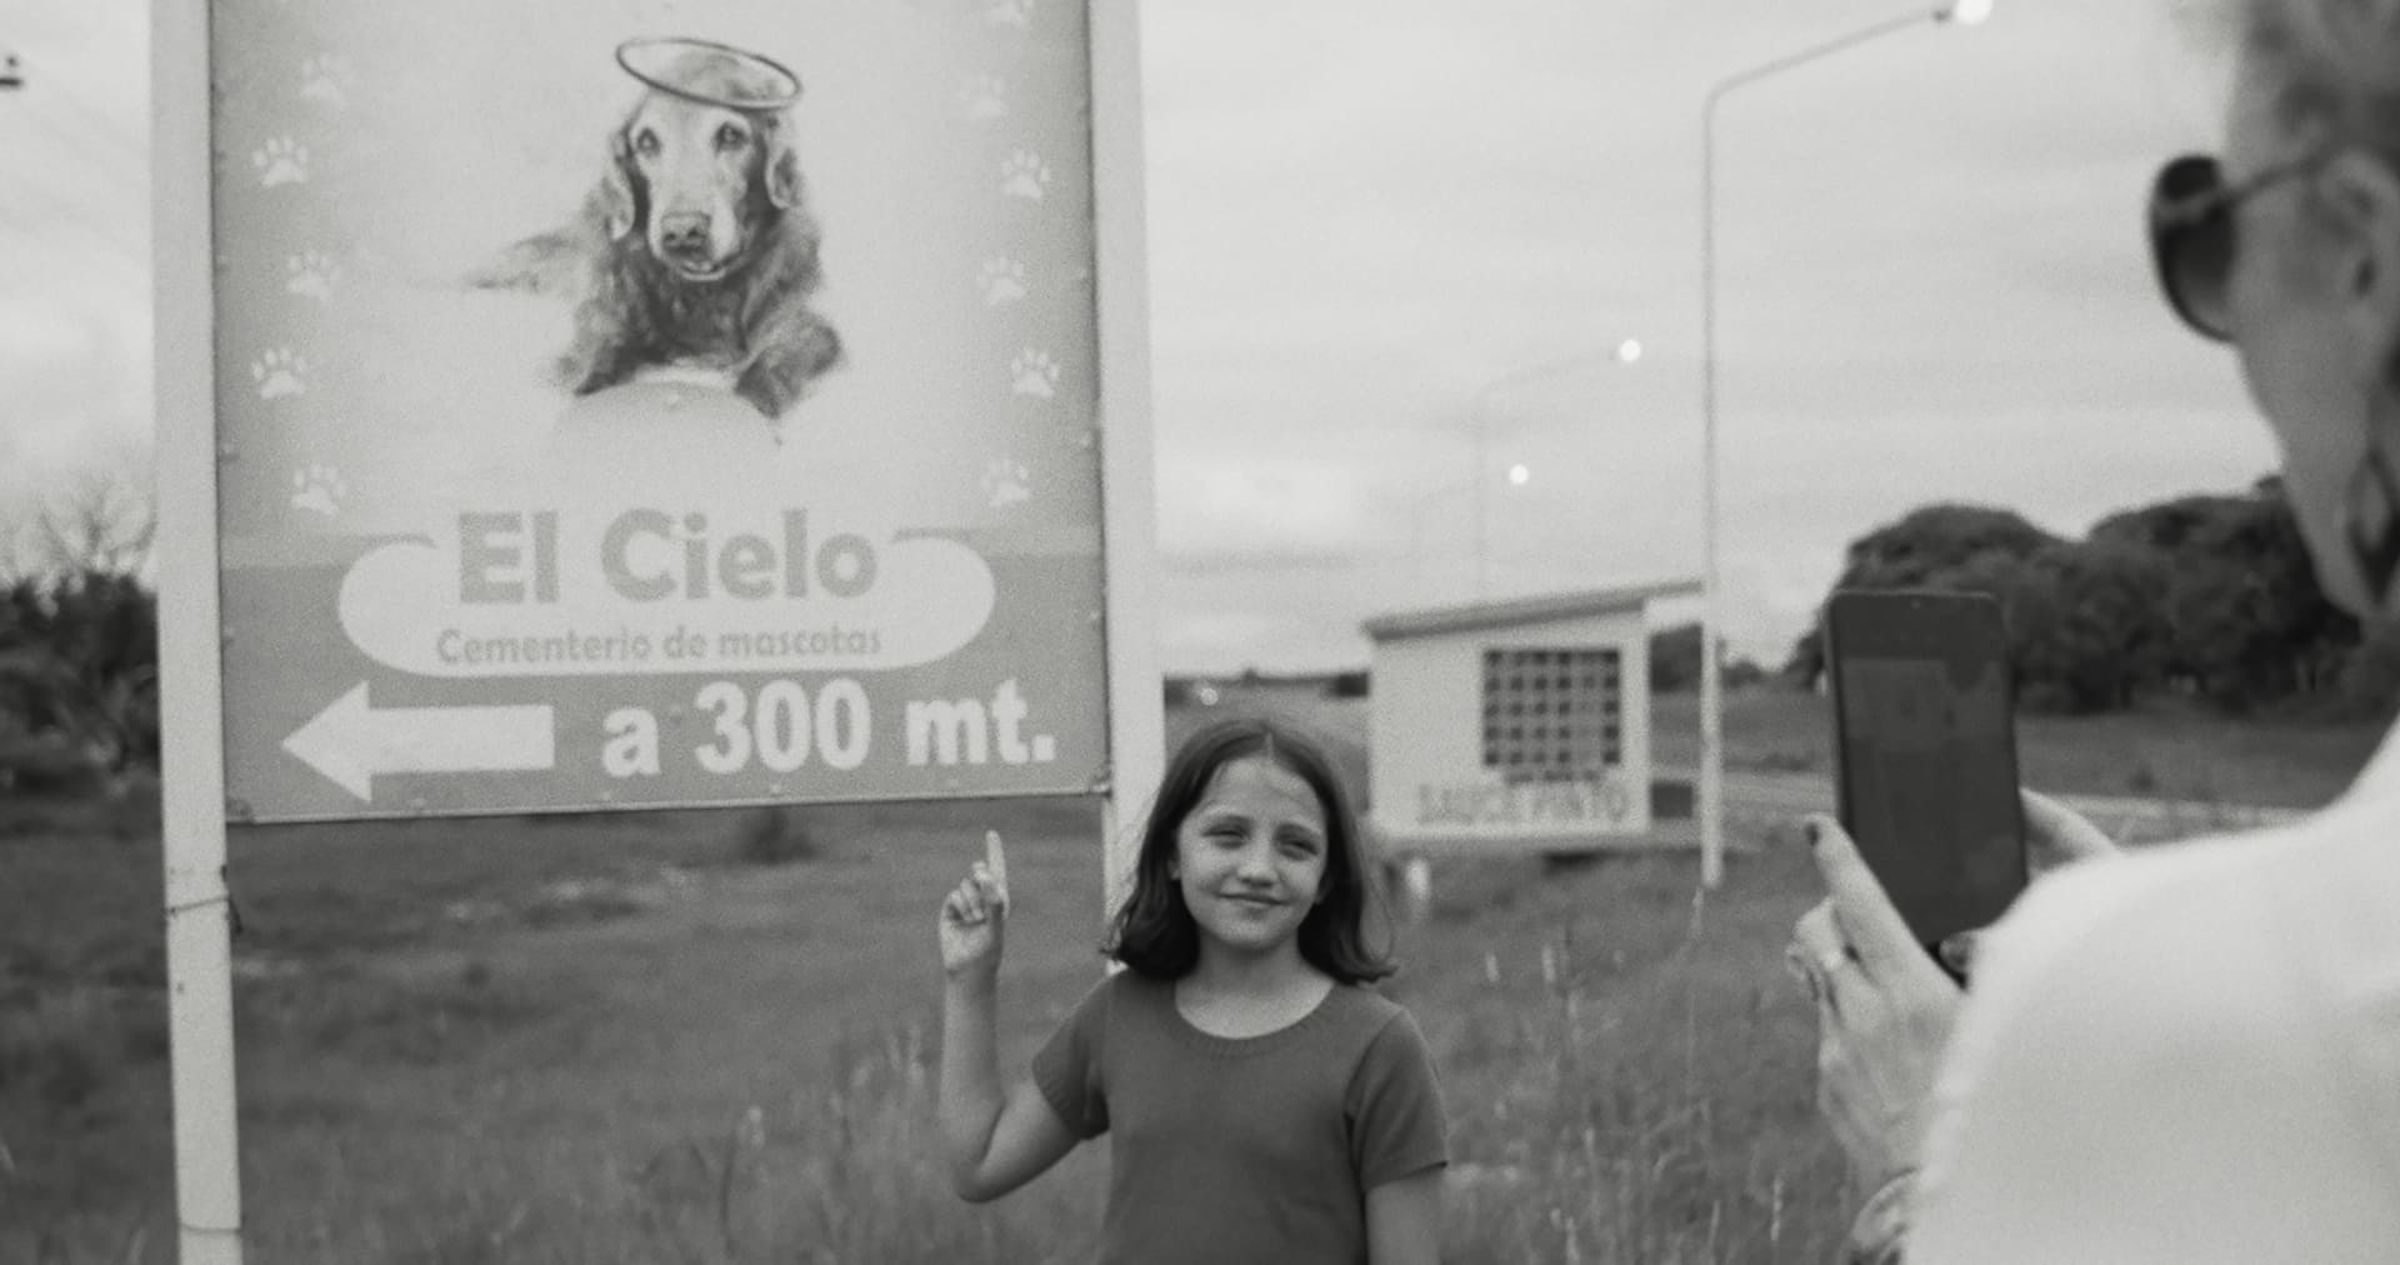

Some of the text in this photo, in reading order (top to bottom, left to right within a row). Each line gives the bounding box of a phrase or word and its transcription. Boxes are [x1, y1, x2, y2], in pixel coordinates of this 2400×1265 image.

[460, 508, 876, 602] El Cielo
[437, 623, 881, 663] Cementerio de mascotas
[603, 679, 1055, 777] a 300 mt.
